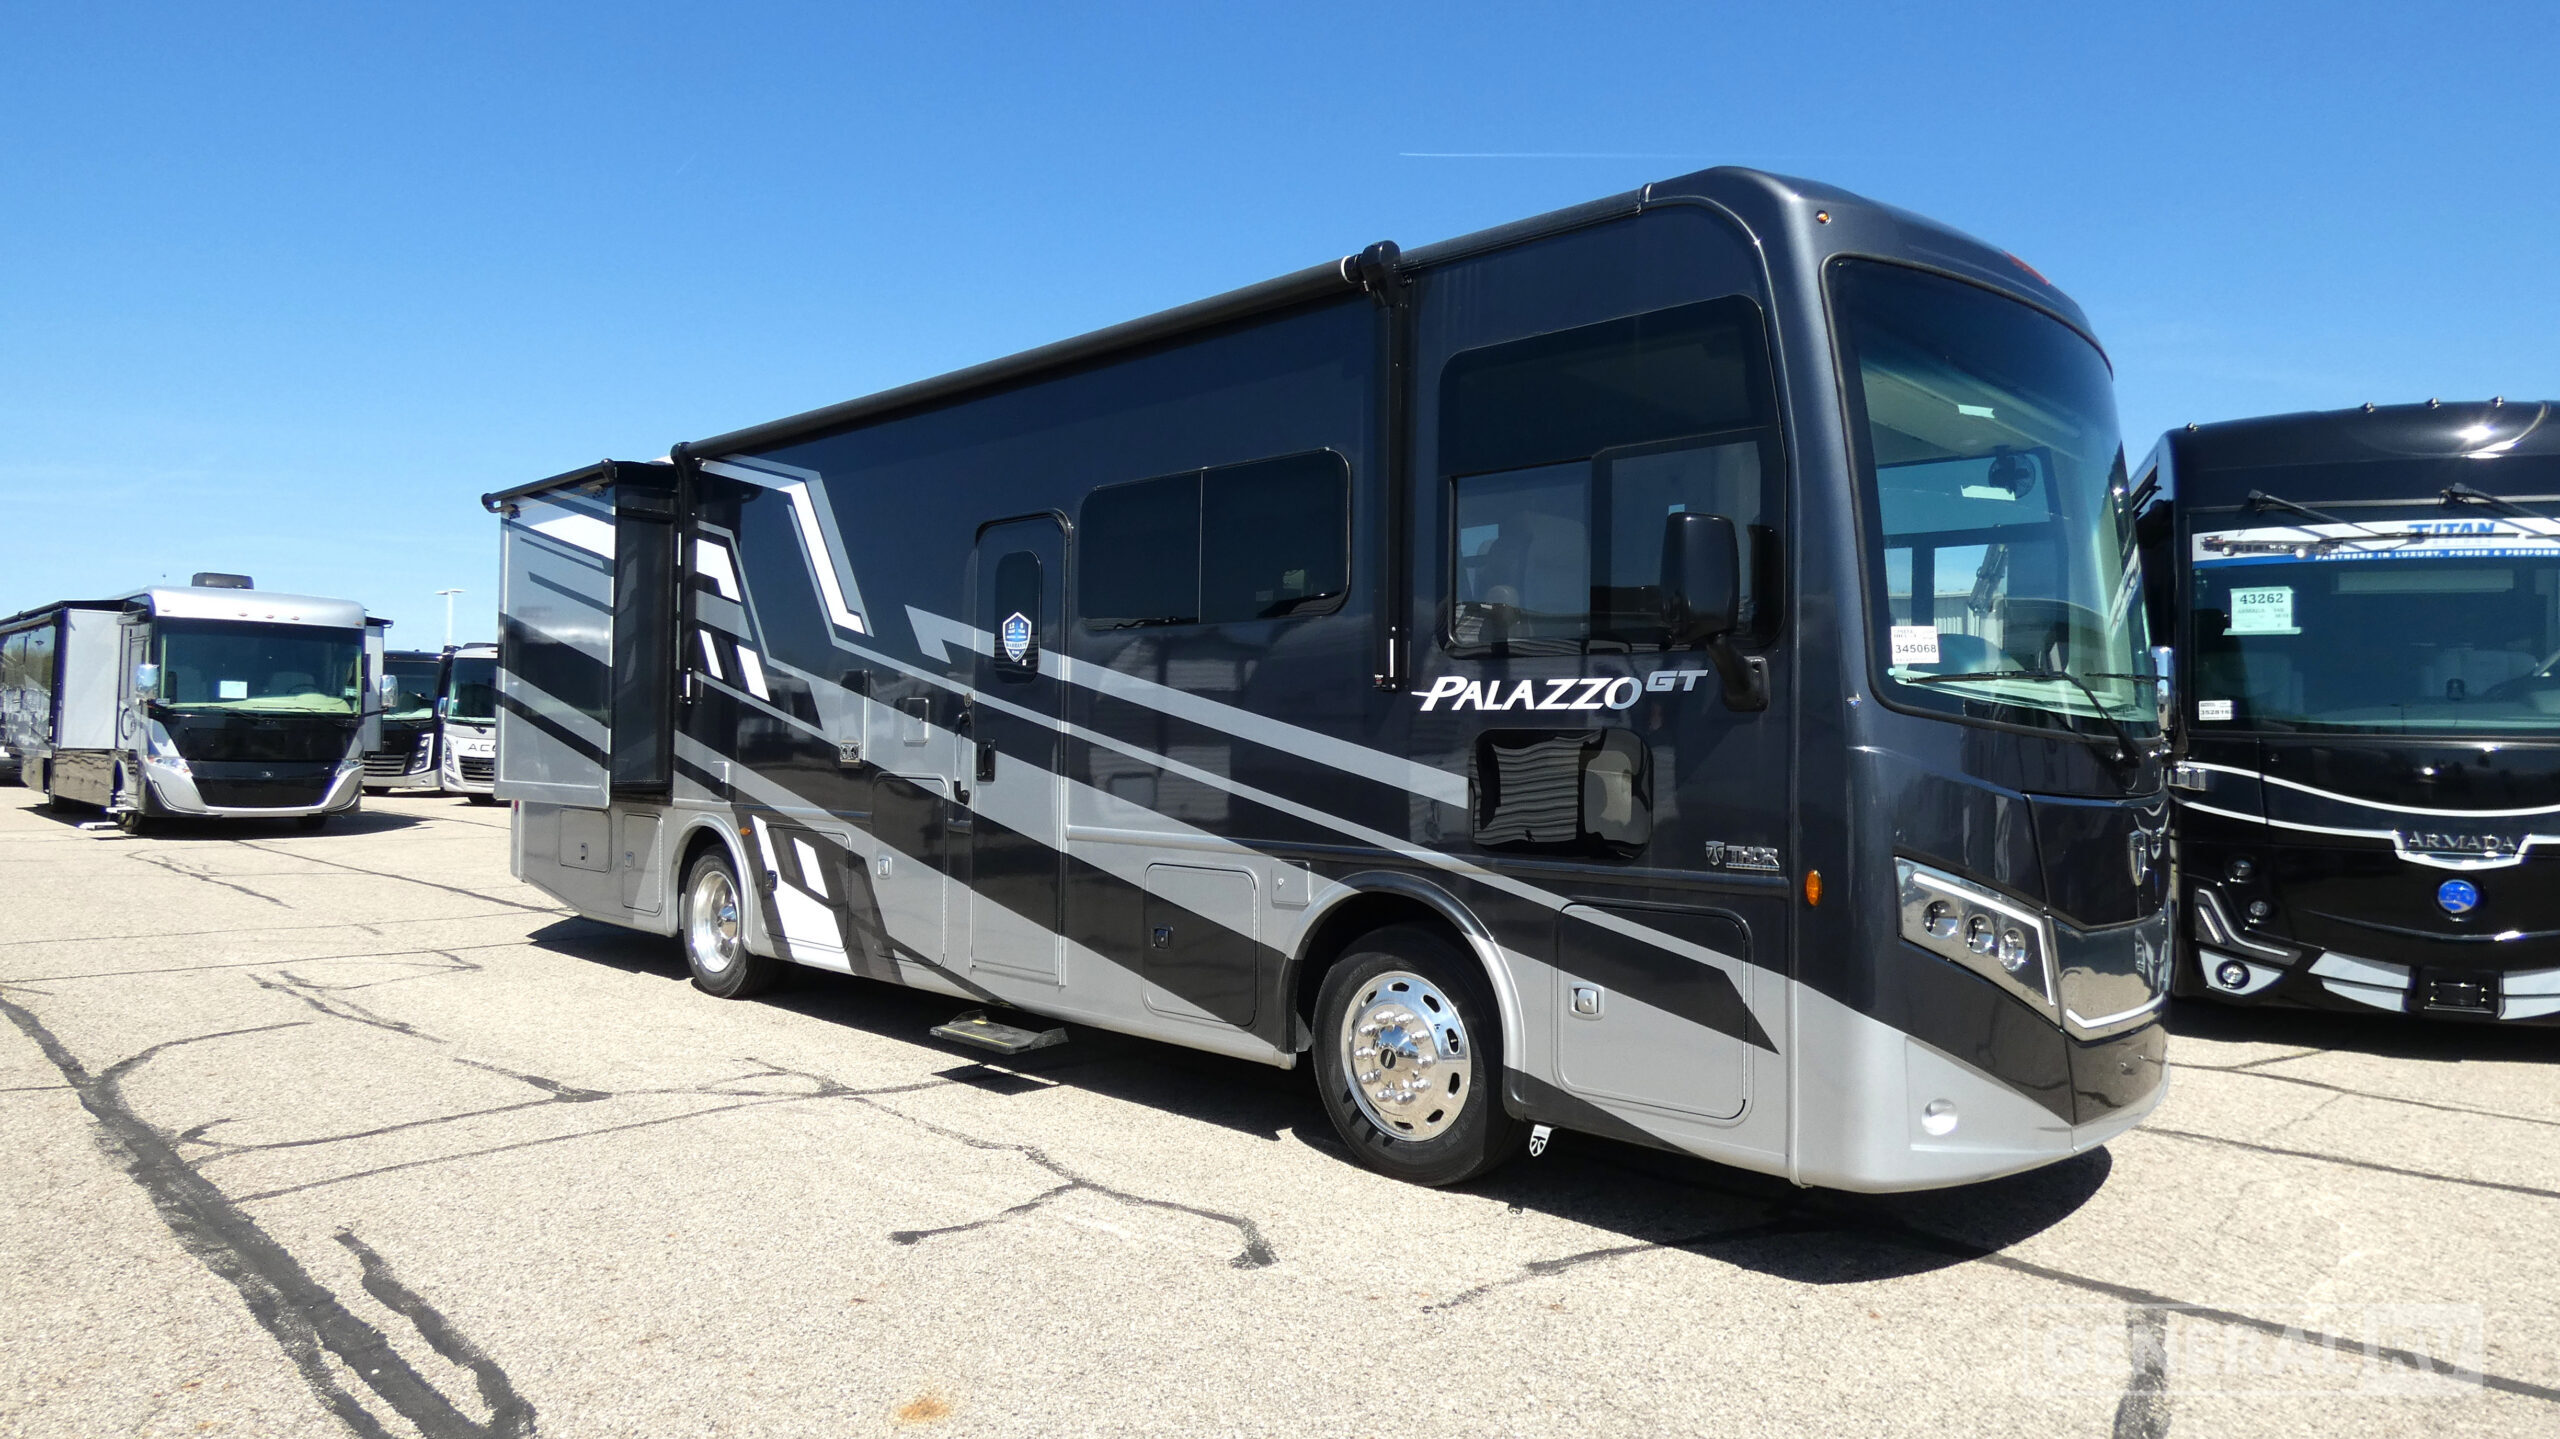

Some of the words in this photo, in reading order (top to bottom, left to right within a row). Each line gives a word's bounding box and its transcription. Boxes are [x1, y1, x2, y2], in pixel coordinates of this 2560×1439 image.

[2407, 522, 2496, 538] TITAN
[2315, 552, 2373, 561] PARTNERS
[2448, 549, 2489, 557] POWER
[2240, 593, 2284, 605] 43262
[1895, 644, 1937, 654] 345068
[1411, 675, 1643, 711] PALAZZO
[1645, 669, 1709, 692] GT
[2408, 830, 2518, 851] ARMADA
[1726, 845, 1780, 866] THOR
